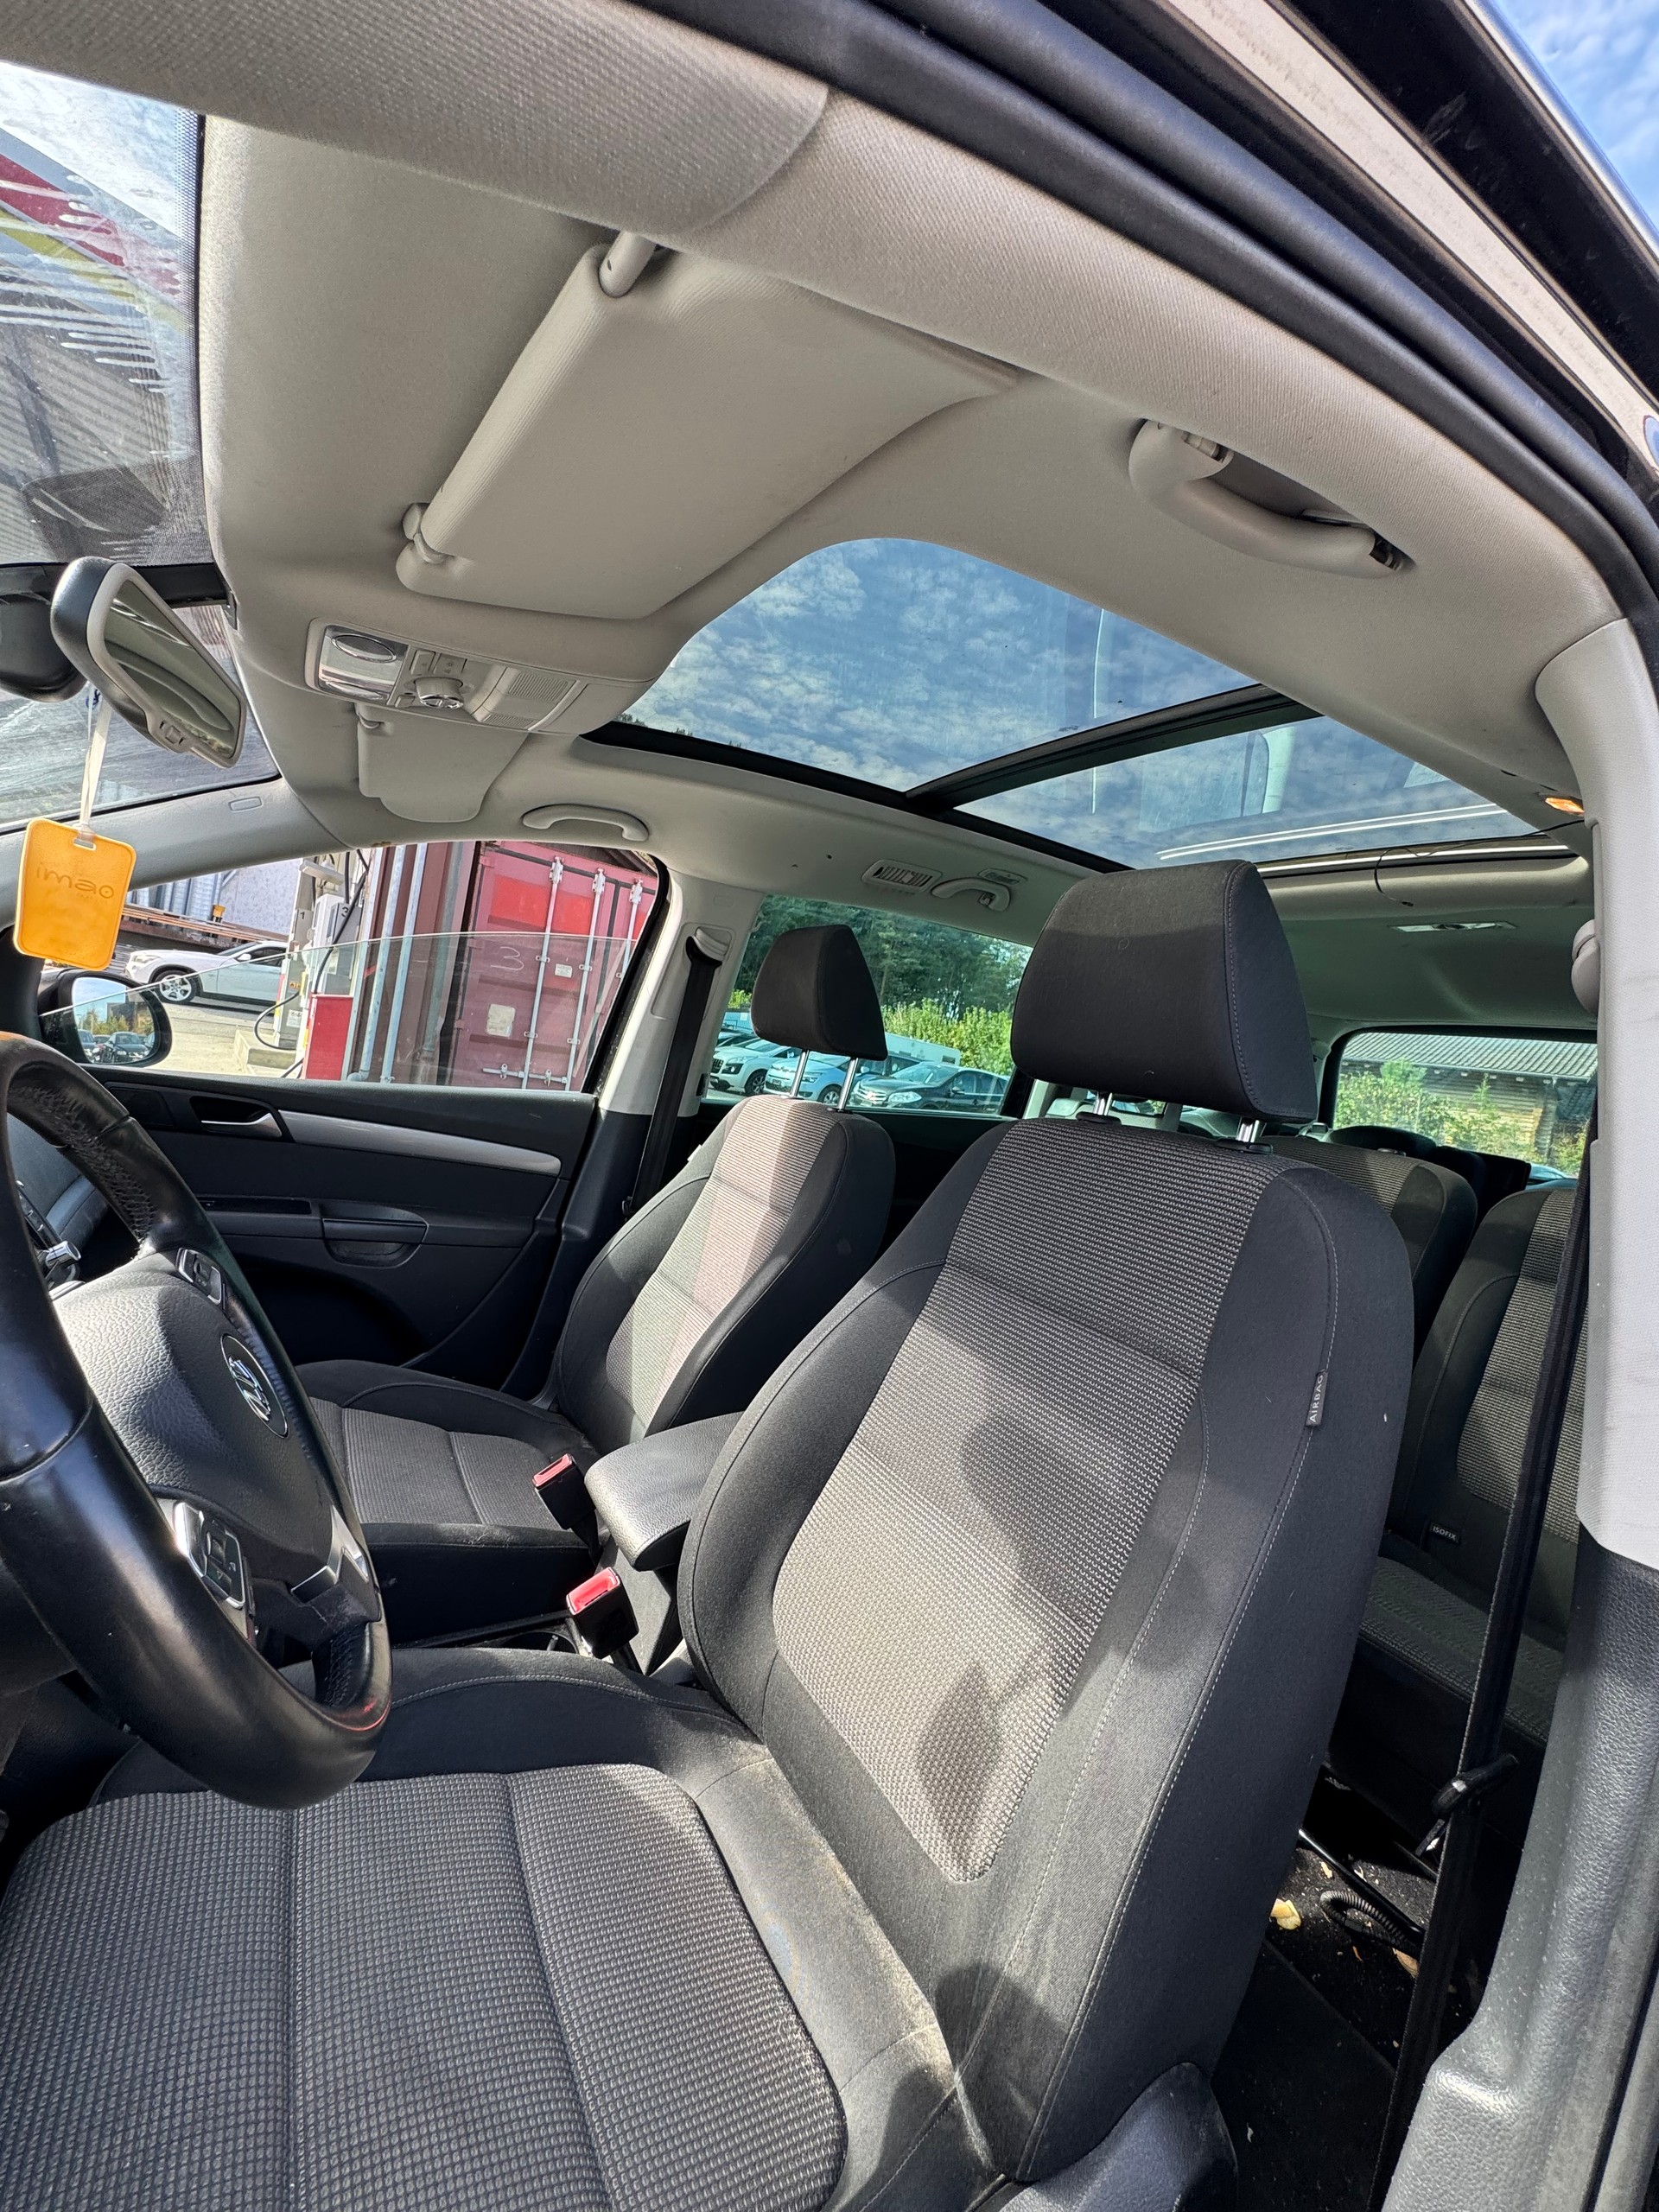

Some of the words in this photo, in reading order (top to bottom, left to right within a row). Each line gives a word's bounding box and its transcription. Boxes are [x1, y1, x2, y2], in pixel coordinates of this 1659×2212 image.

[37, 861, 114, 899] imao
[490, 946, 524, 971] 3
[1309, 1375, 1324, 1423] AIRBAG
[1432, 1525, 1457, 1541] ISOFIX
